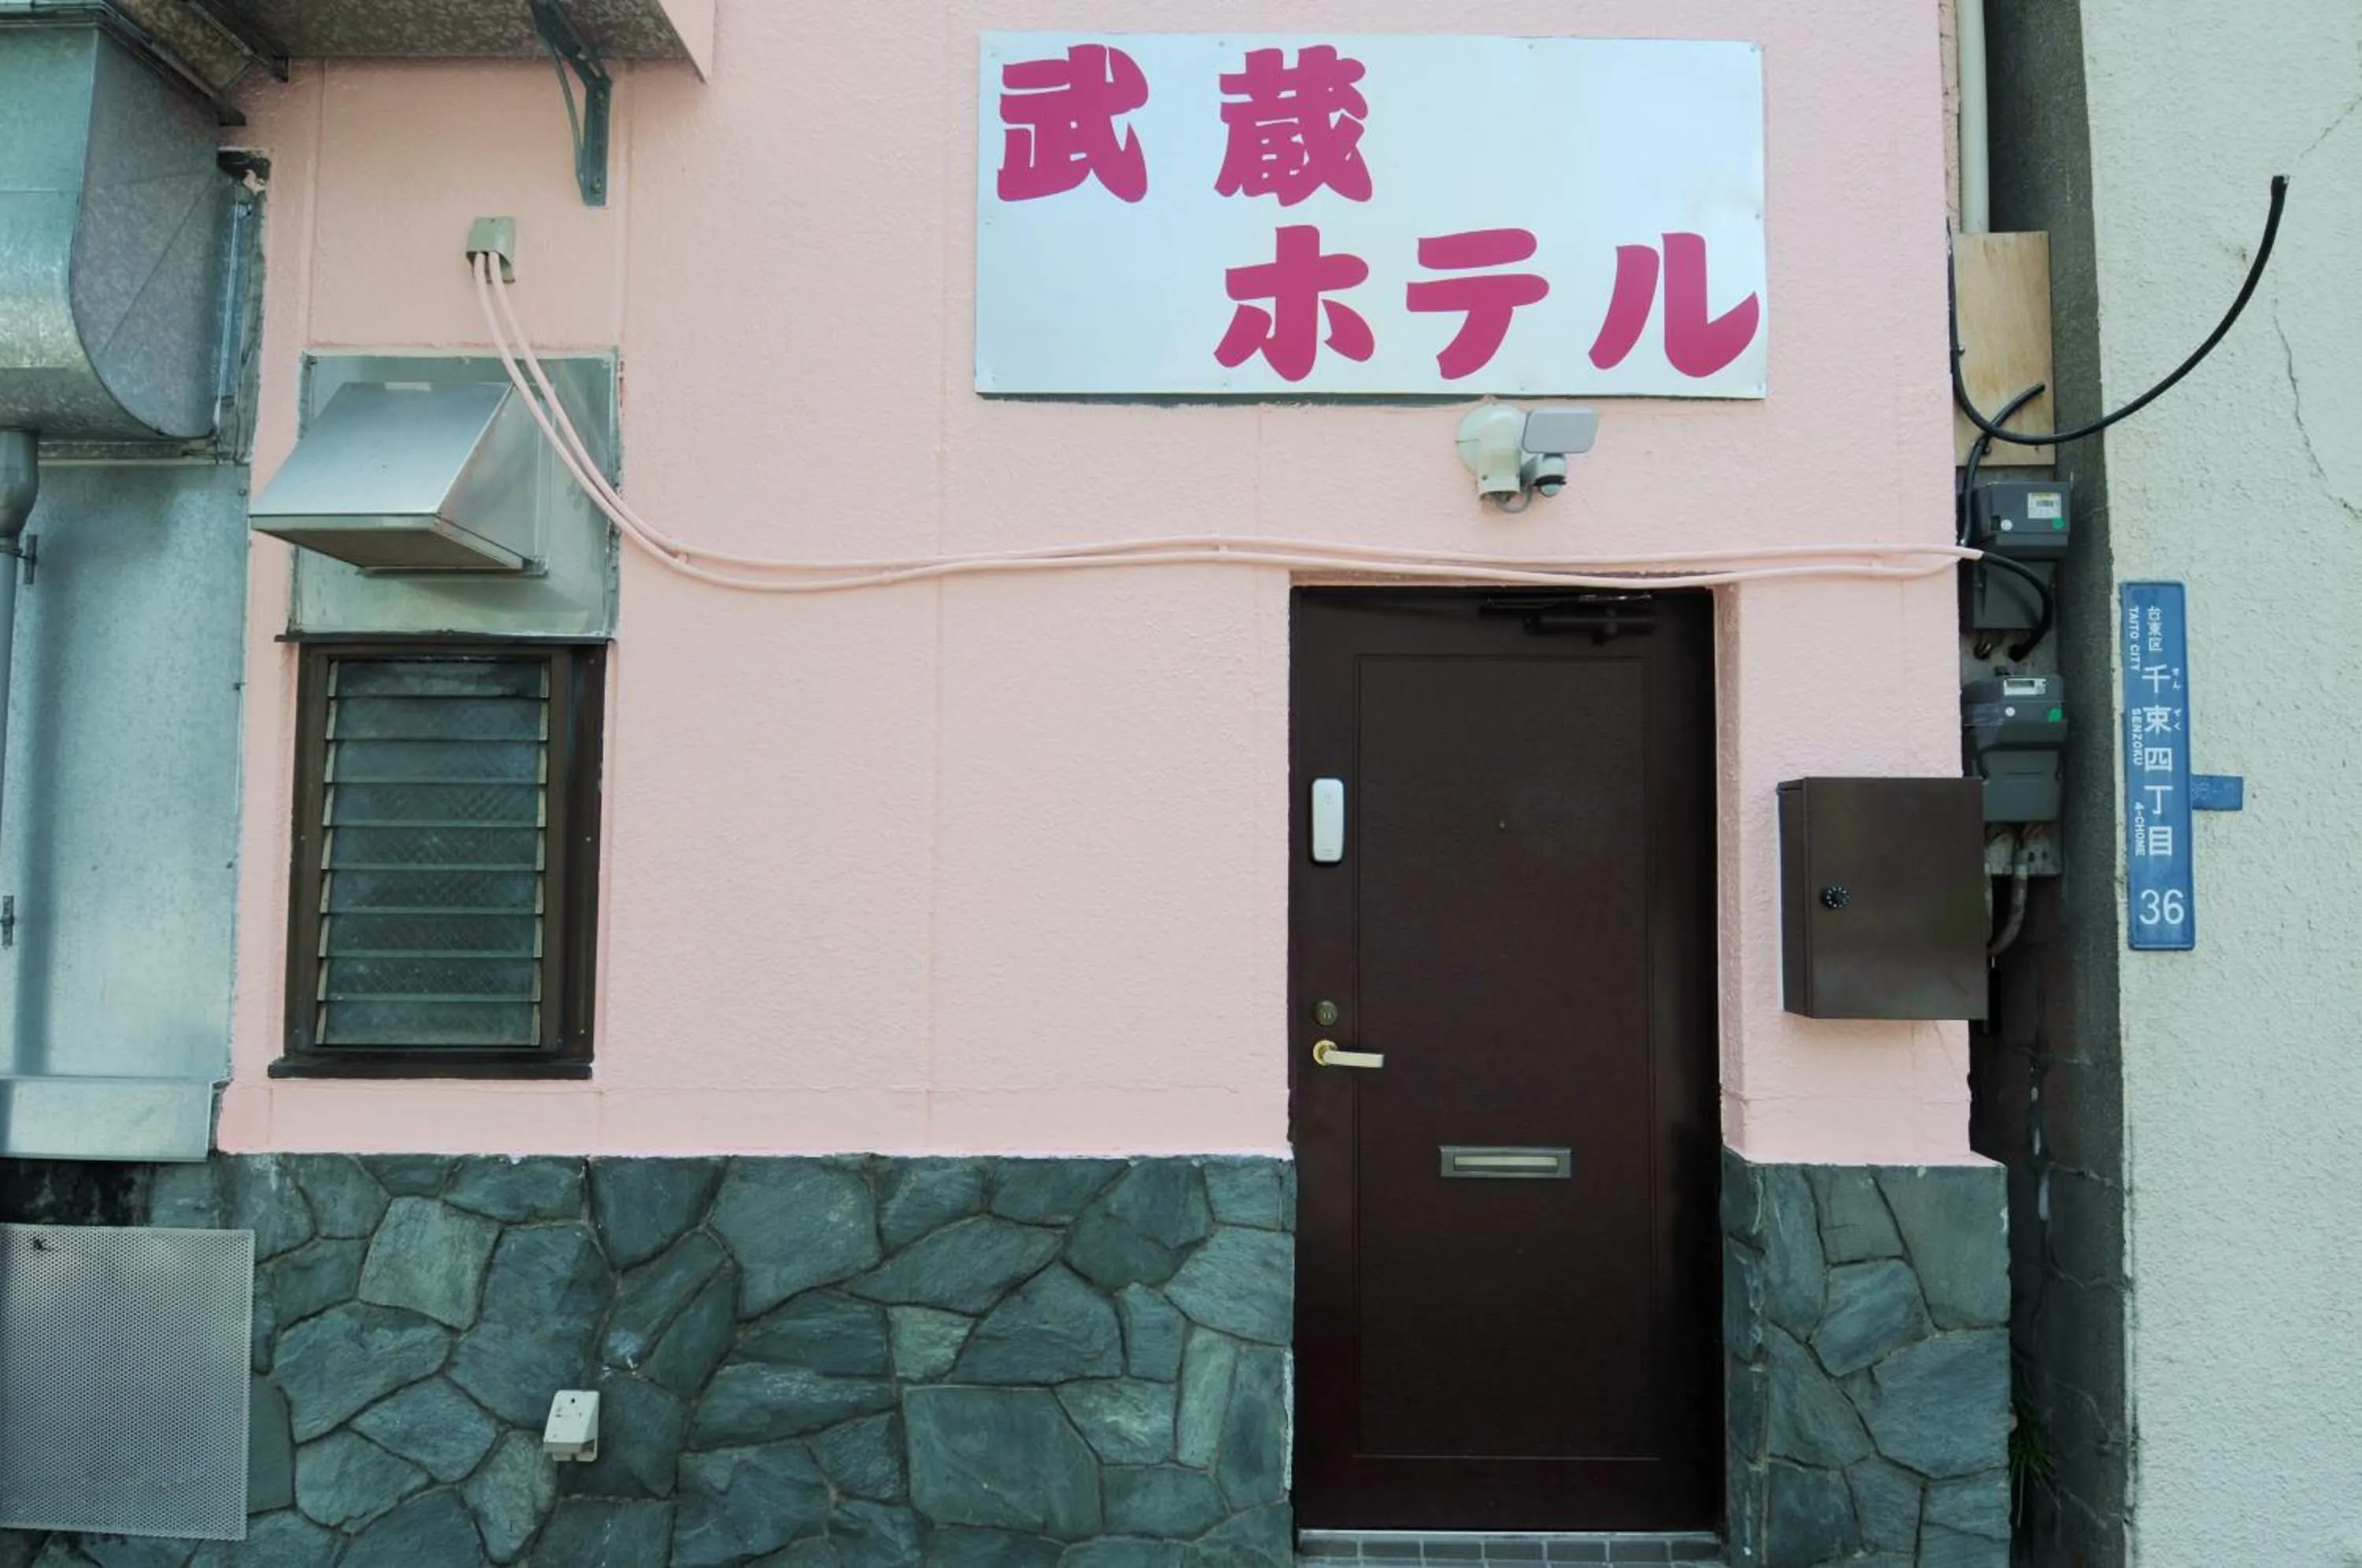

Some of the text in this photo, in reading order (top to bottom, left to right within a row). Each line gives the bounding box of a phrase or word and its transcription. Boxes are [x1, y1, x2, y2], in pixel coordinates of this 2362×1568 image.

[1213, 224, 1760, 382] ホテル
[2128, 605, 2141, 671] TAITO CITY
[2131, 707, 2144, 767] SENZOKU
[2141, 664, 2174, 856] 千束四丁目
[2134, 801, 2145, 857] 4-CHOME
[2138, 889, 2185, 926] 36
